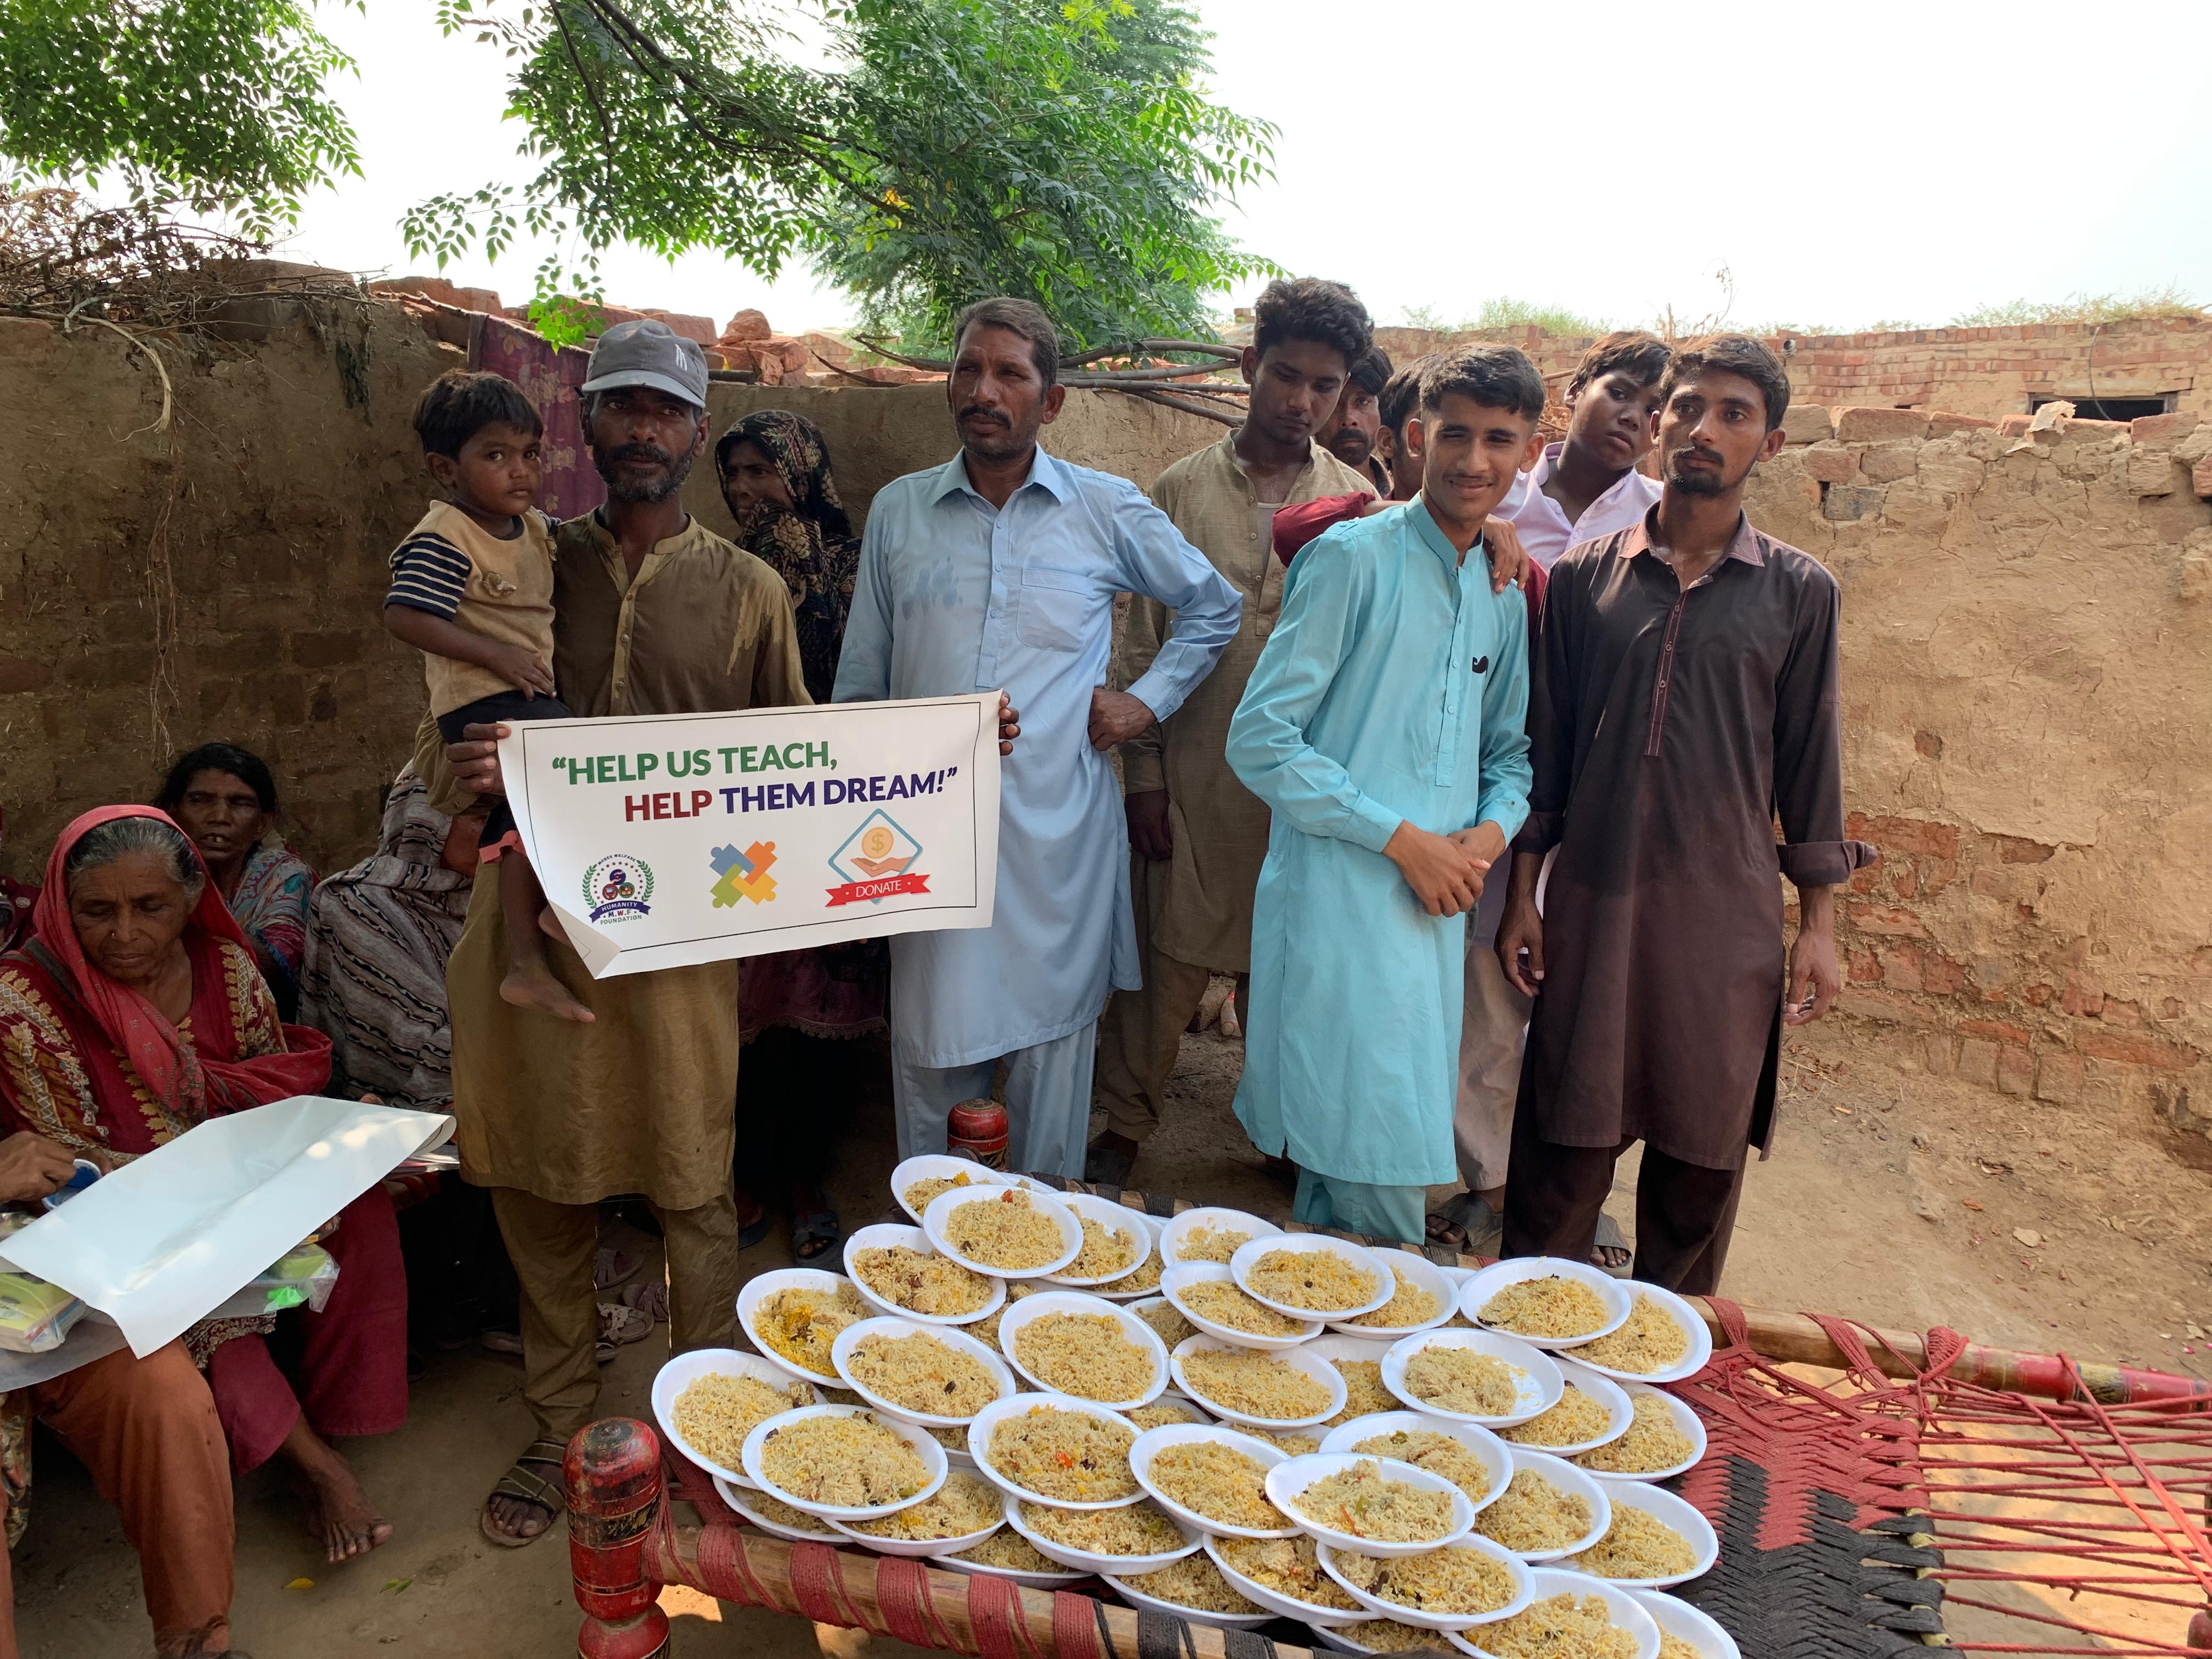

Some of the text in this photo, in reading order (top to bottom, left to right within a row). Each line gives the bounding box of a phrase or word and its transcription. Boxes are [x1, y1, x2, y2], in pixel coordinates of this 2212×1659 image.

[667, 748, 711, 779] US
[717, 741, 838, 774] TEACH,
[624, 791, 713, 822] HELP
[719, 781, 816, 814] THEM
[598, 854, 636, 866] MOSES WELFARE
[856, 879, 902, 898] DONATE
[601, 902, 638, 911] HUMANITY
[600, 915, 642, 925] FOUNDATION
